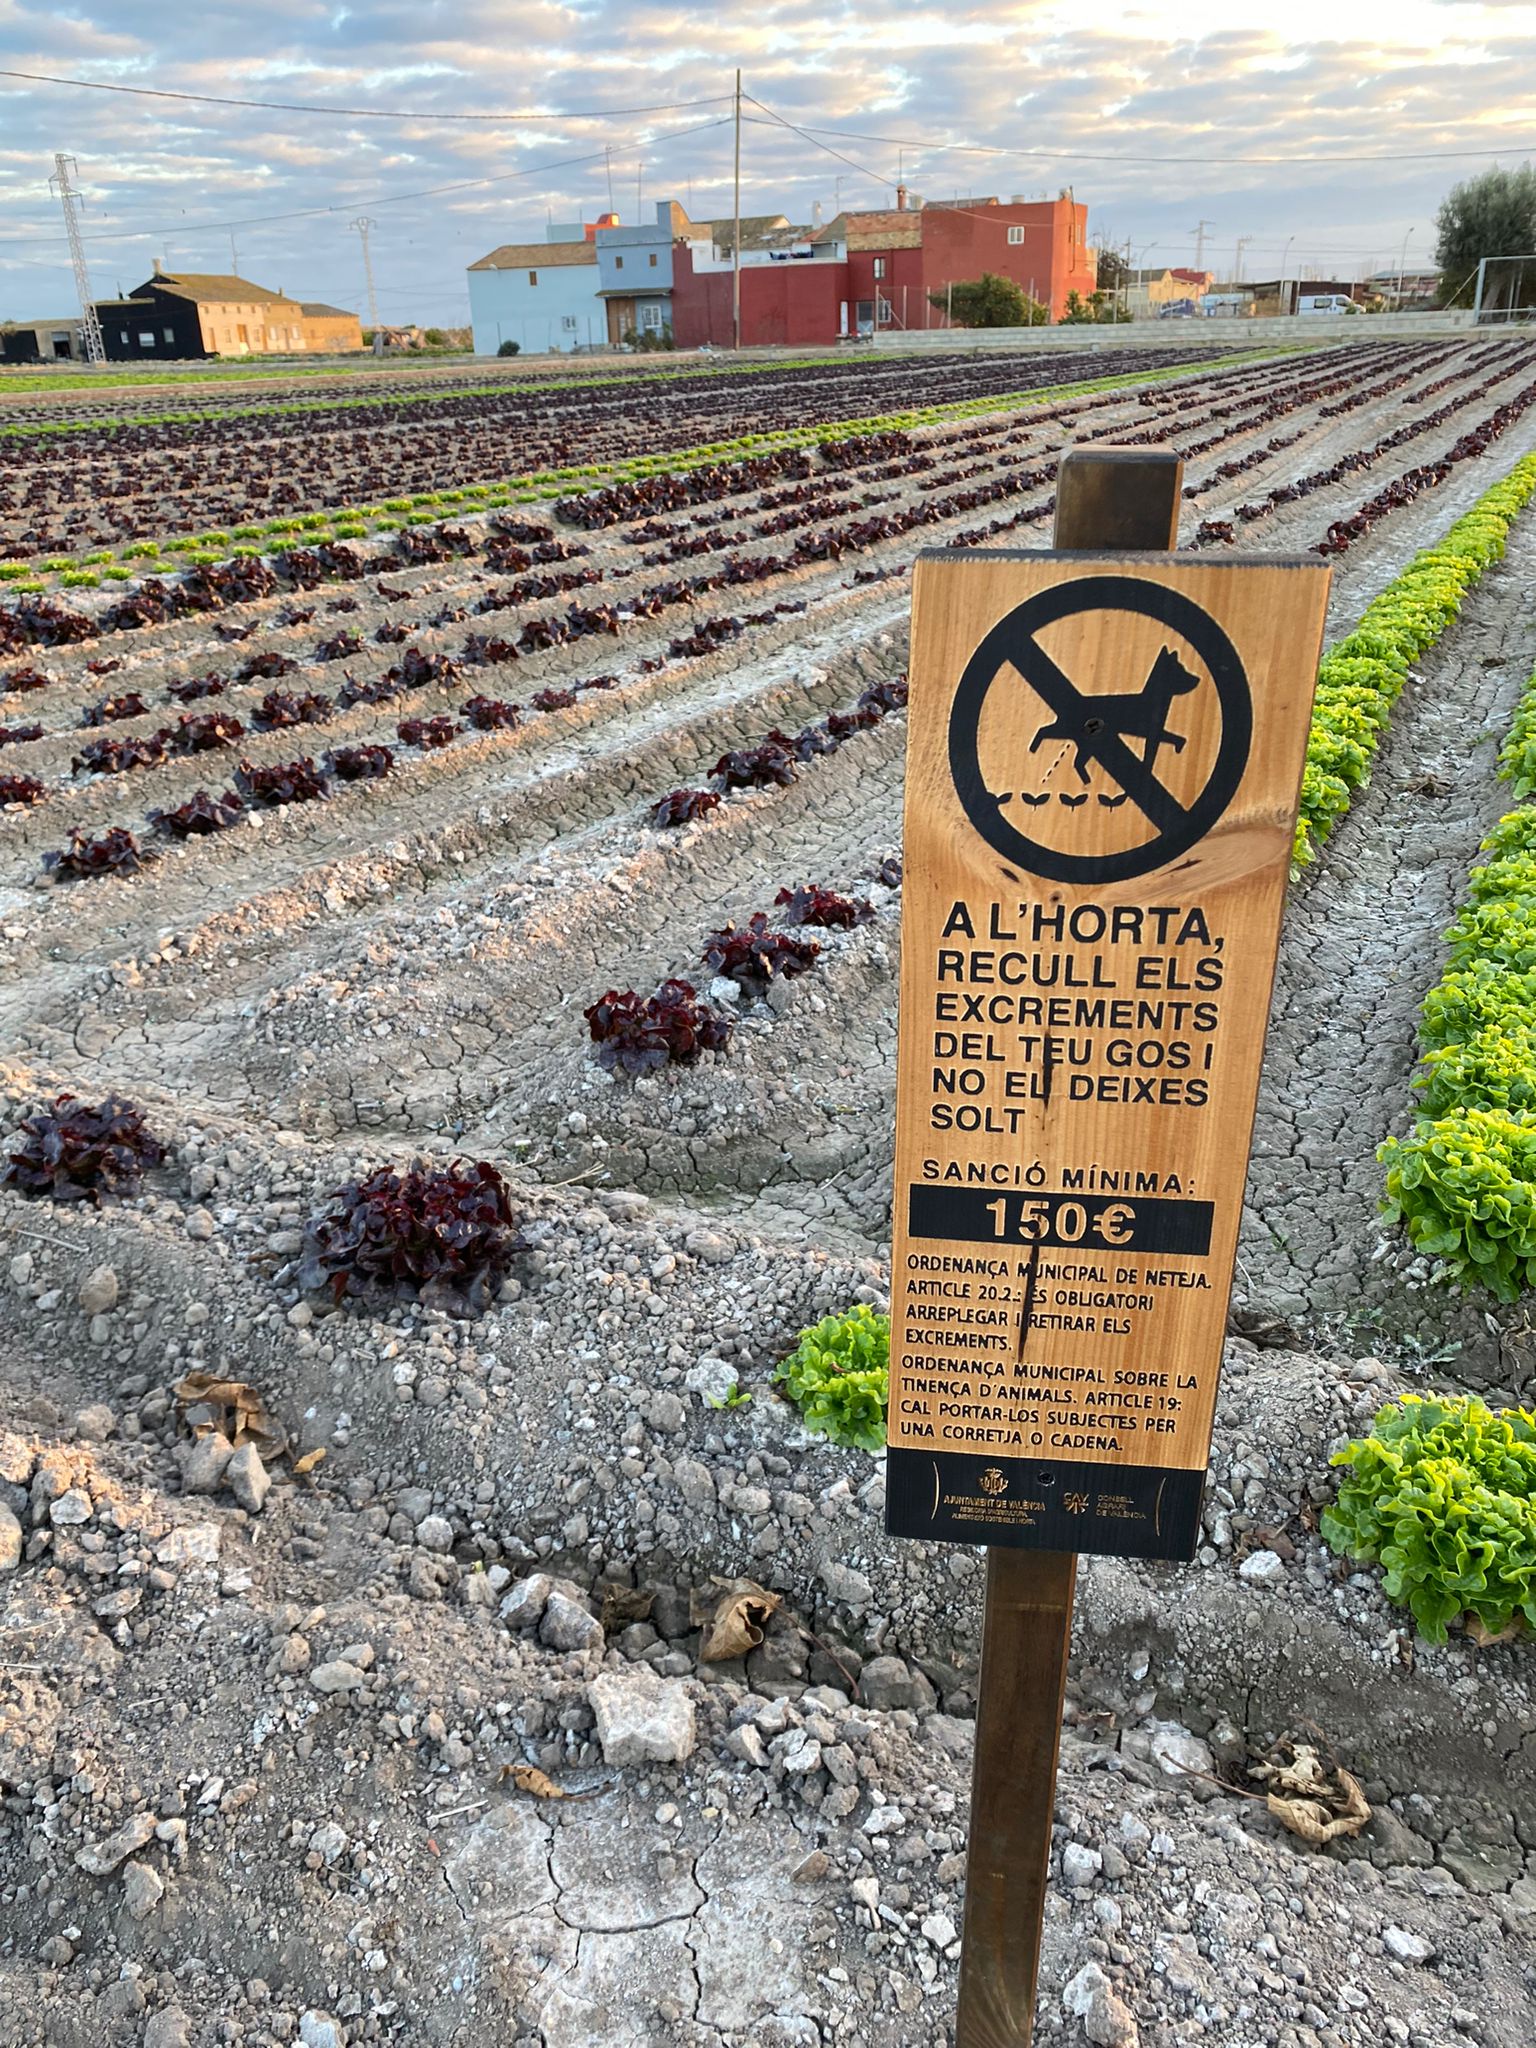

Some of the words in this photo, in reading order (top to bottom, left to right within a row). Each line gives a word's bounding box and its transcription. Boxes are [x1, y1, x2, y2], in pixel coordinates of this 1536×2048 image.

[942, 901, 976, 939] A
[989, 902, 1224, 954] L'HORTA,
[937, 949, 1117, 988] RECULL
[1136, 957, 1223, 992] ELS
[936, 993, 1218, 1032] EXCREMENTS
[934, 1032, 1006, 1061] DEL
[1018, 1036, 1092, 1065] TEU
[1106, 1039, 1190, 1069] GOS
[1204, 1043, 1213, 1070] I
[932, 1068, 985, 1095] NO
[1005, 1071, 1049, 1099] EL
[1069, 1075, 1209, 1106] DEIXES
[930, 1104, 1026, 1134] SOLT
[922, 1159, 1046, 1187] SANCIÓ
[1062, 1164, 1195, 1194] MÍNIMA:
[985, 1197, 1137, 1245] 150€
[907, 1254, 1009, 1279] ORDENANÇA
[1017, 1262, 1108, 1283] MUNICIPAL
[1115, 1268, 1138, 1284] DE
[1145, 1269, 1212, 1289] NETEJA.
[906, 1279, 971, 1298] ARTICLE
[1055, 1290, 1154, 1311] OBLIGATORI
[906, 1304, 1008, 1326] ARREPLEGAR
[1028, 1313, 1096, 1332] RETIRAR
[1103, 1318, 1131, 1334] ELS
[906, 1328, 1013, 1351] EXCREMENTS.
[901, 1355, 1005, 1379] ORDENANÇA
[1013, 1364, 1106, 1384] MUNICIPAL
[1113, 1370, 1169, 1388] SOBRE
[1177, 1374, 1198, 1390] LA
[901, 1377, 971, 1398] TINENÇA
[1085, 1391, 1153, 1409] ARTICLE
[1159, 1396, 1182, 1411] 19:
[900, 1400, 931, 1415] CAL
[939, 1402, 1039, 1423] PORTAR-LOS
[1047, 1411, 1137, 1430] SUBJECTES
[1145, 1417, 1176, 1433] PER
[900, 1421, 934, 1437] UNA
[942, 1425, 1022, 1444] CORRETJA
[1030, 1432, 1043, 1446] O
[1050, 1433, 1123, 1451] CADENA.
